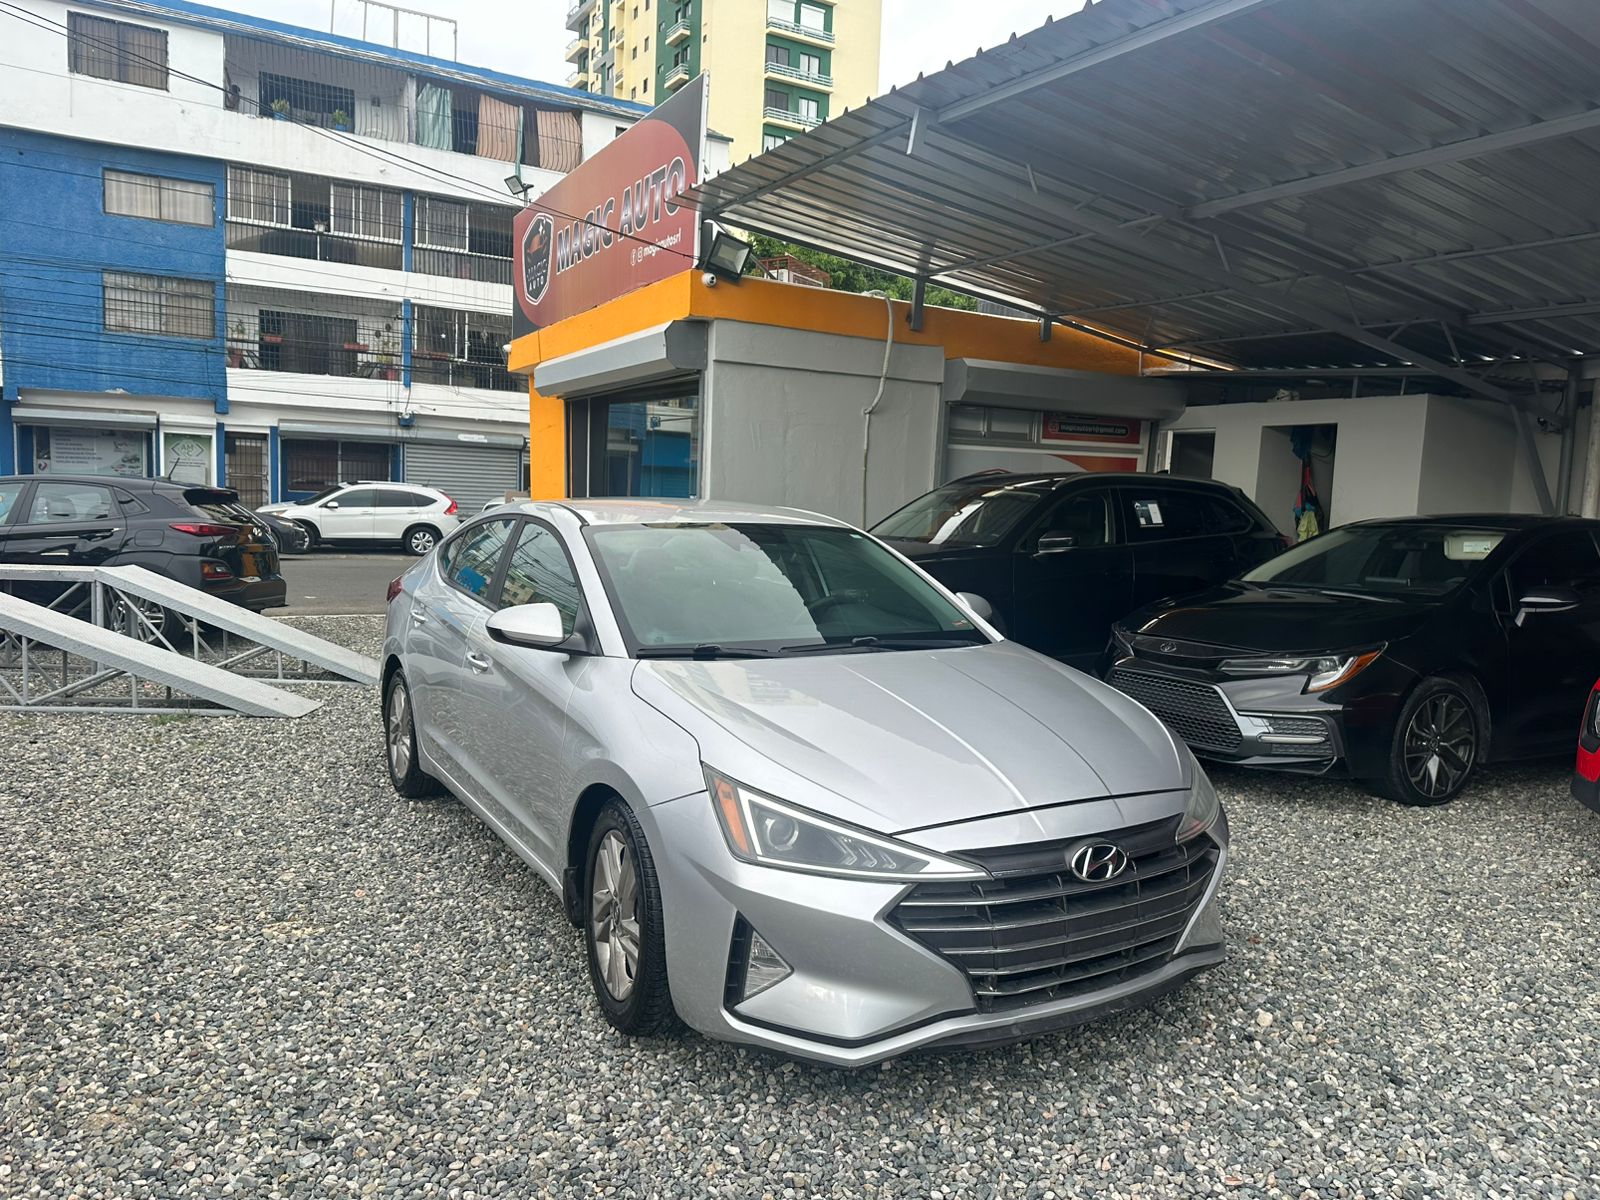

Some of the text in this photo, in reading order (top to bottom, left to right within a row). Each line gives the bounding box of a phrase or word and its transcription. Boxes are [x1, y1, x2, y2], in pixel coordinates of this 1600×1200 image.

[556, 156, 686, 275] MAGIC AUTO
[527, 259, 548, 282] MAGIC
[529, 275, 545, 292] AUTO
